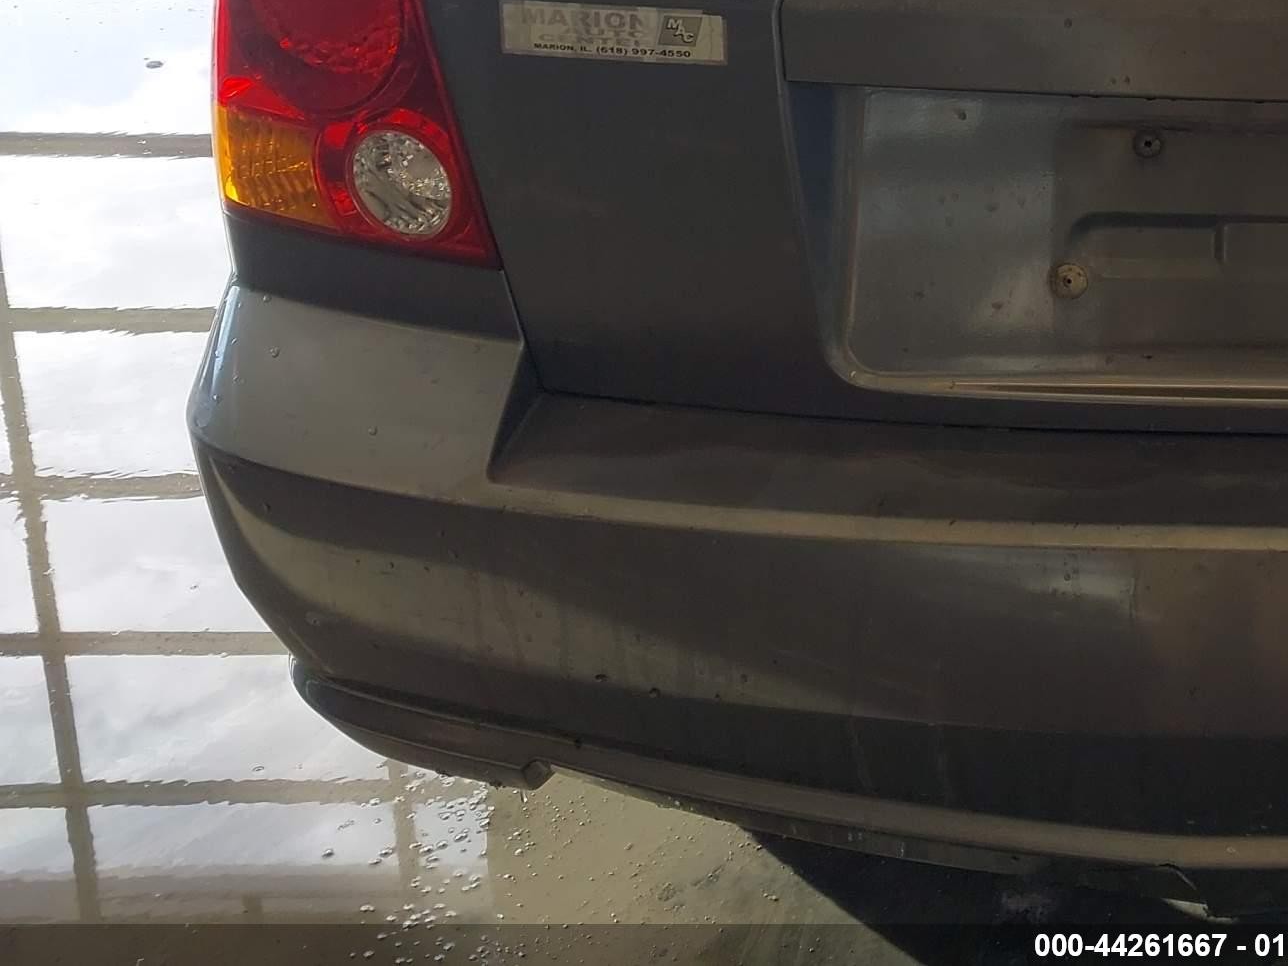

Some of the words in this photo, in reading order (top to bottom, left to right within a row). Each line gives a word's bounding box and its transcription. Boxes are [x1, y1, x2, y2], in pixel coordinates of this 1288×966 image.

[666, 18, 695, 43] MAC
[597, 46, 628, 55] (618)
[632, 48, 691, 57] 997-4550
